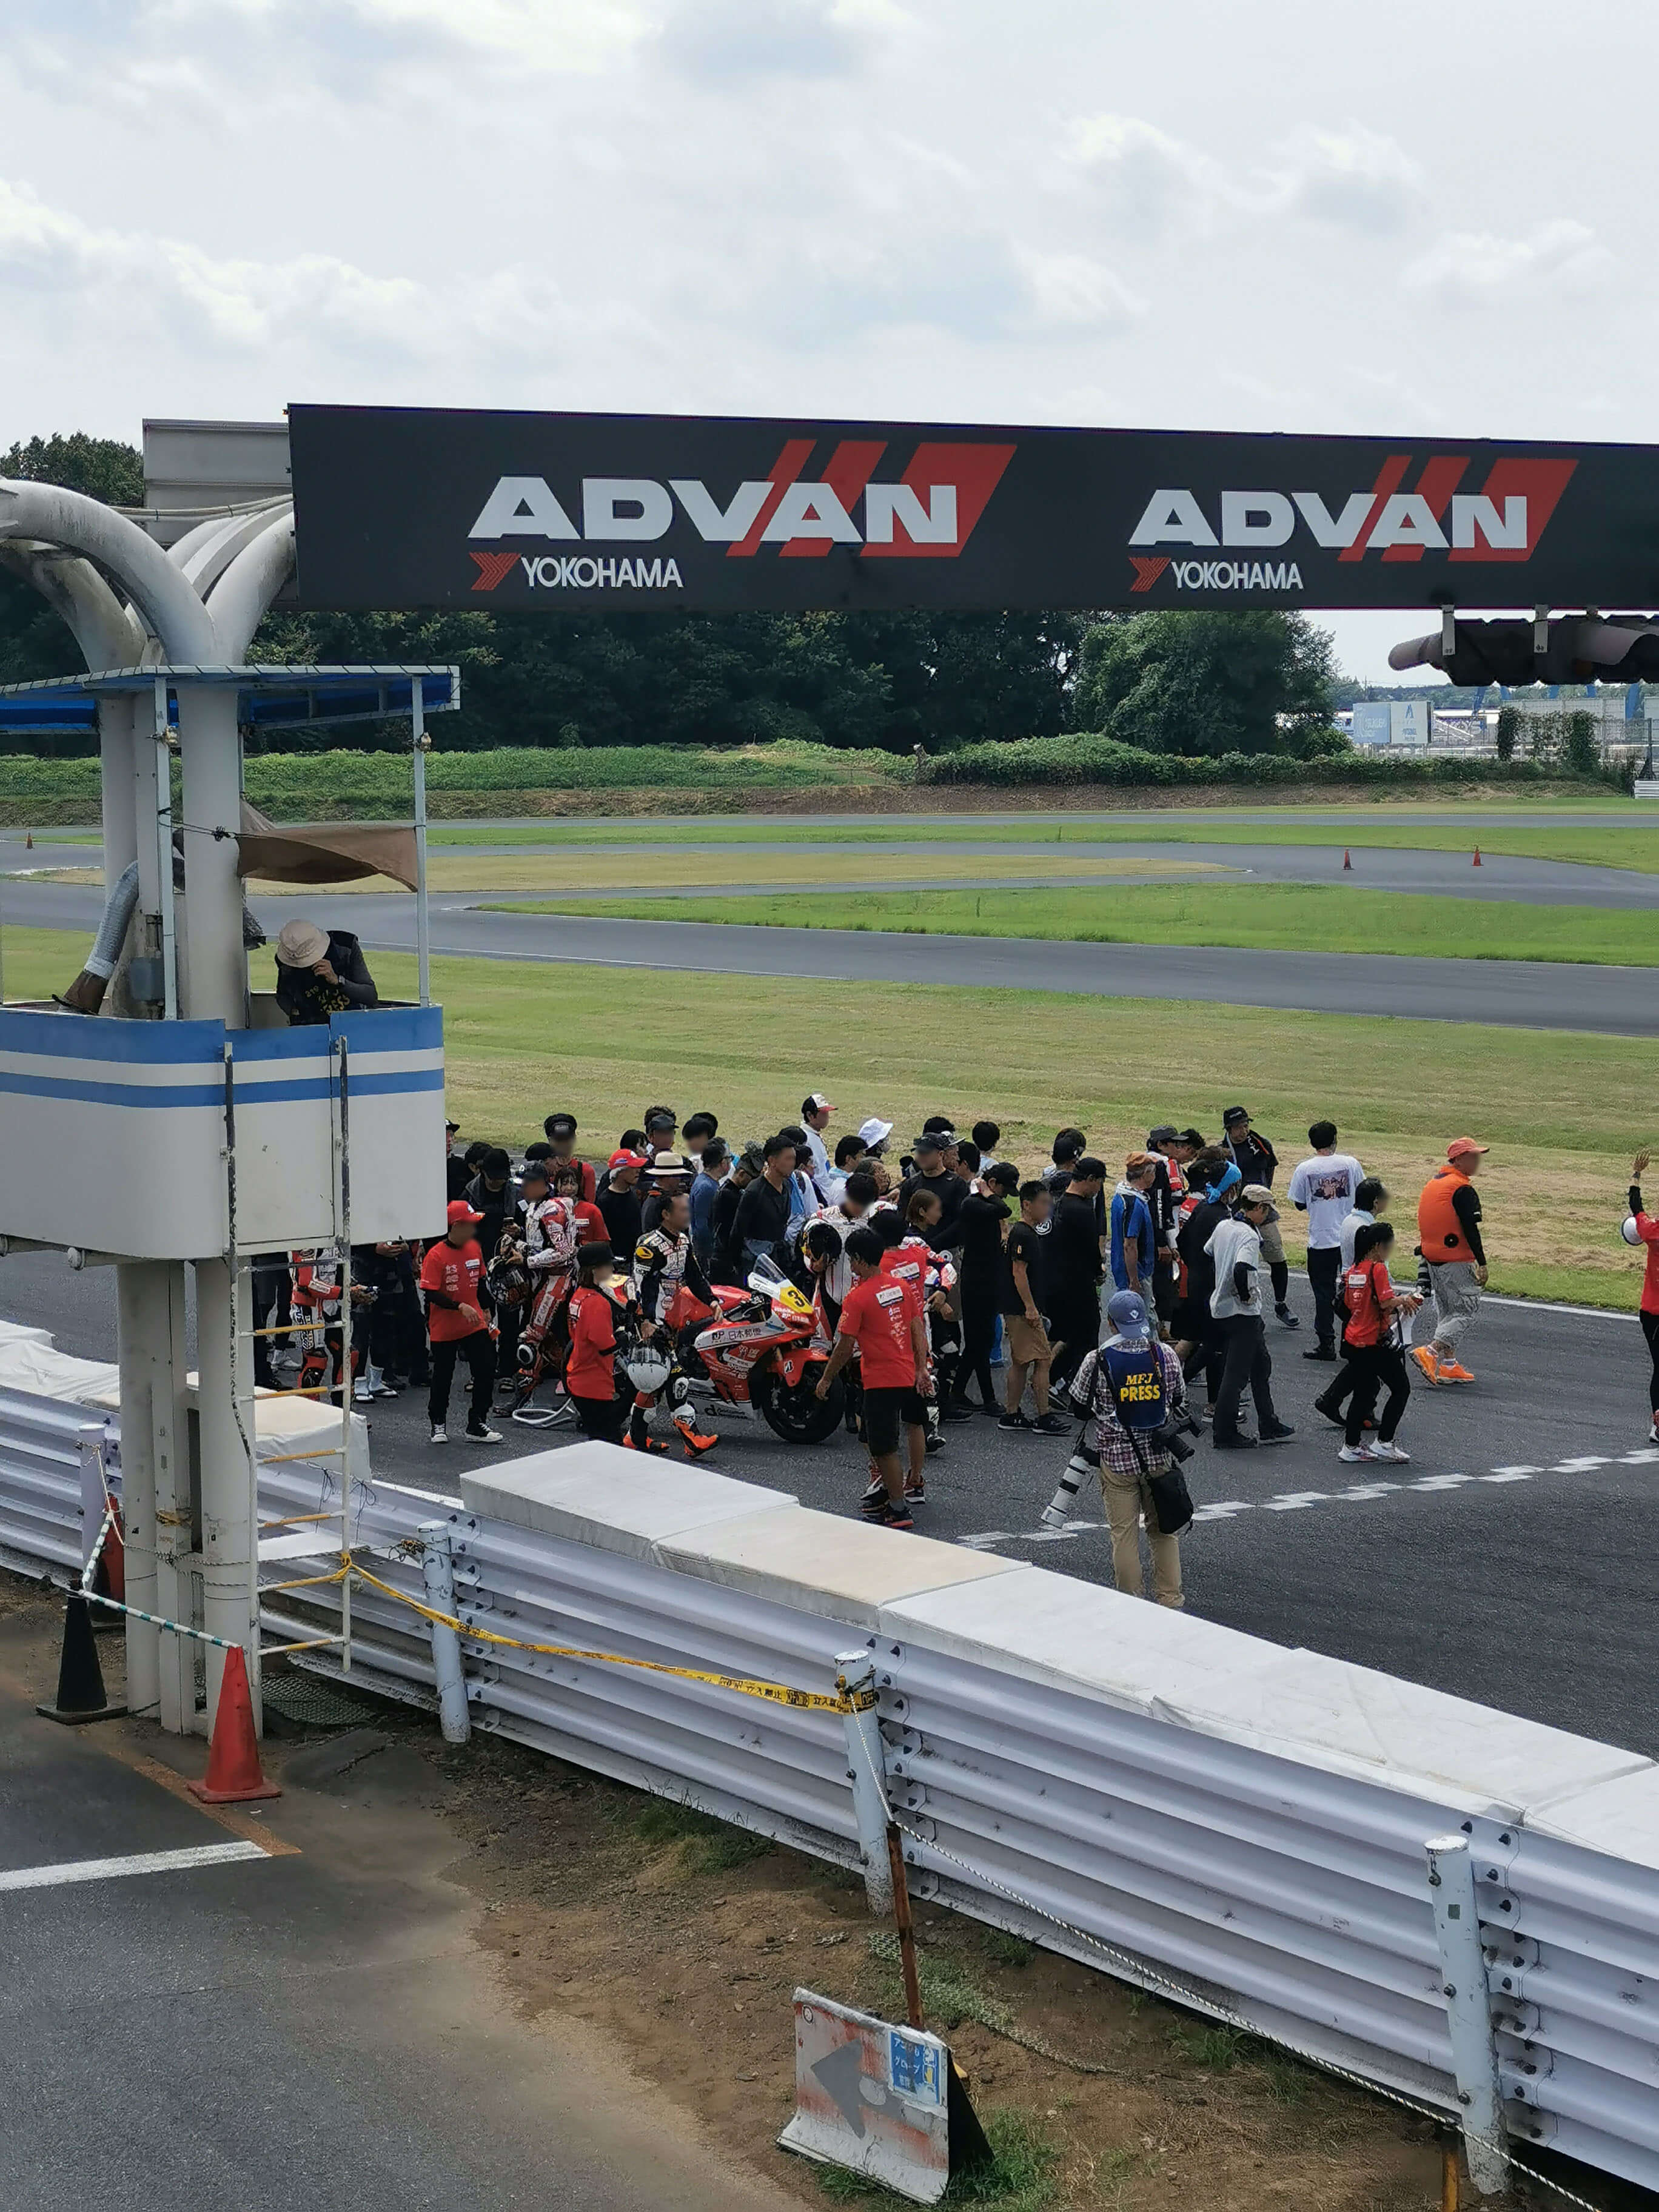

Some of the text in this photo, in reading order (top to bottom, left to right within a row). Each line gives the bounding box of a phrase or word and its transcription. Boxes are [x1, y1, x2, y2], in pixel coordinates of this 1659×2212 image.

[468, 475, 957, 543] ADVAN
[1128, 489, 1527, 549] ADVAN
[521, 556, 683, 589] YOKOHAMA
[1171, 561, 1304, 591] YOKOHAMA
[1120, 1384, 1161, 1402] PRESS
[1125, 1373, 1153, 1386] MFJ
